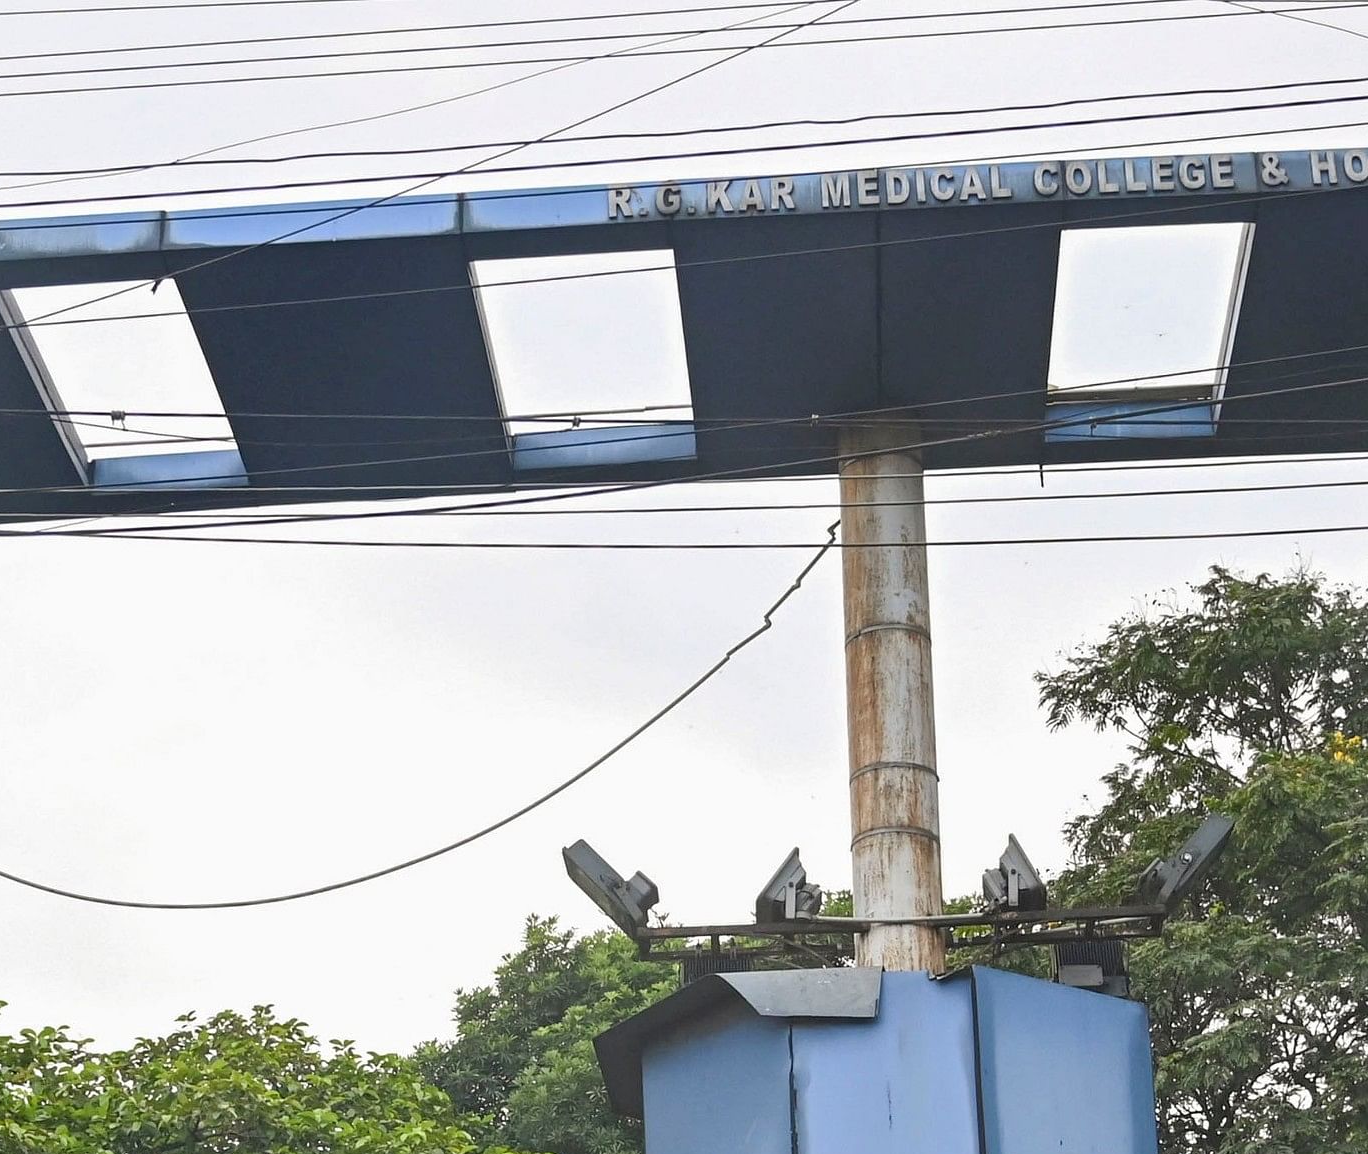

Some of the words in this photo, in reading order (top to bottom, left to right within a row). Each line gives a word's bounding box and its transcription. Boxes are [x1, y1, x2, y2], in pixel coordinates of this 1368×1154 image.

[820, 165, 1013, 208] MEDICAL
[1032, 154, 1235, 196] COLLEGE
[1260, 154, 1289, 187] &
